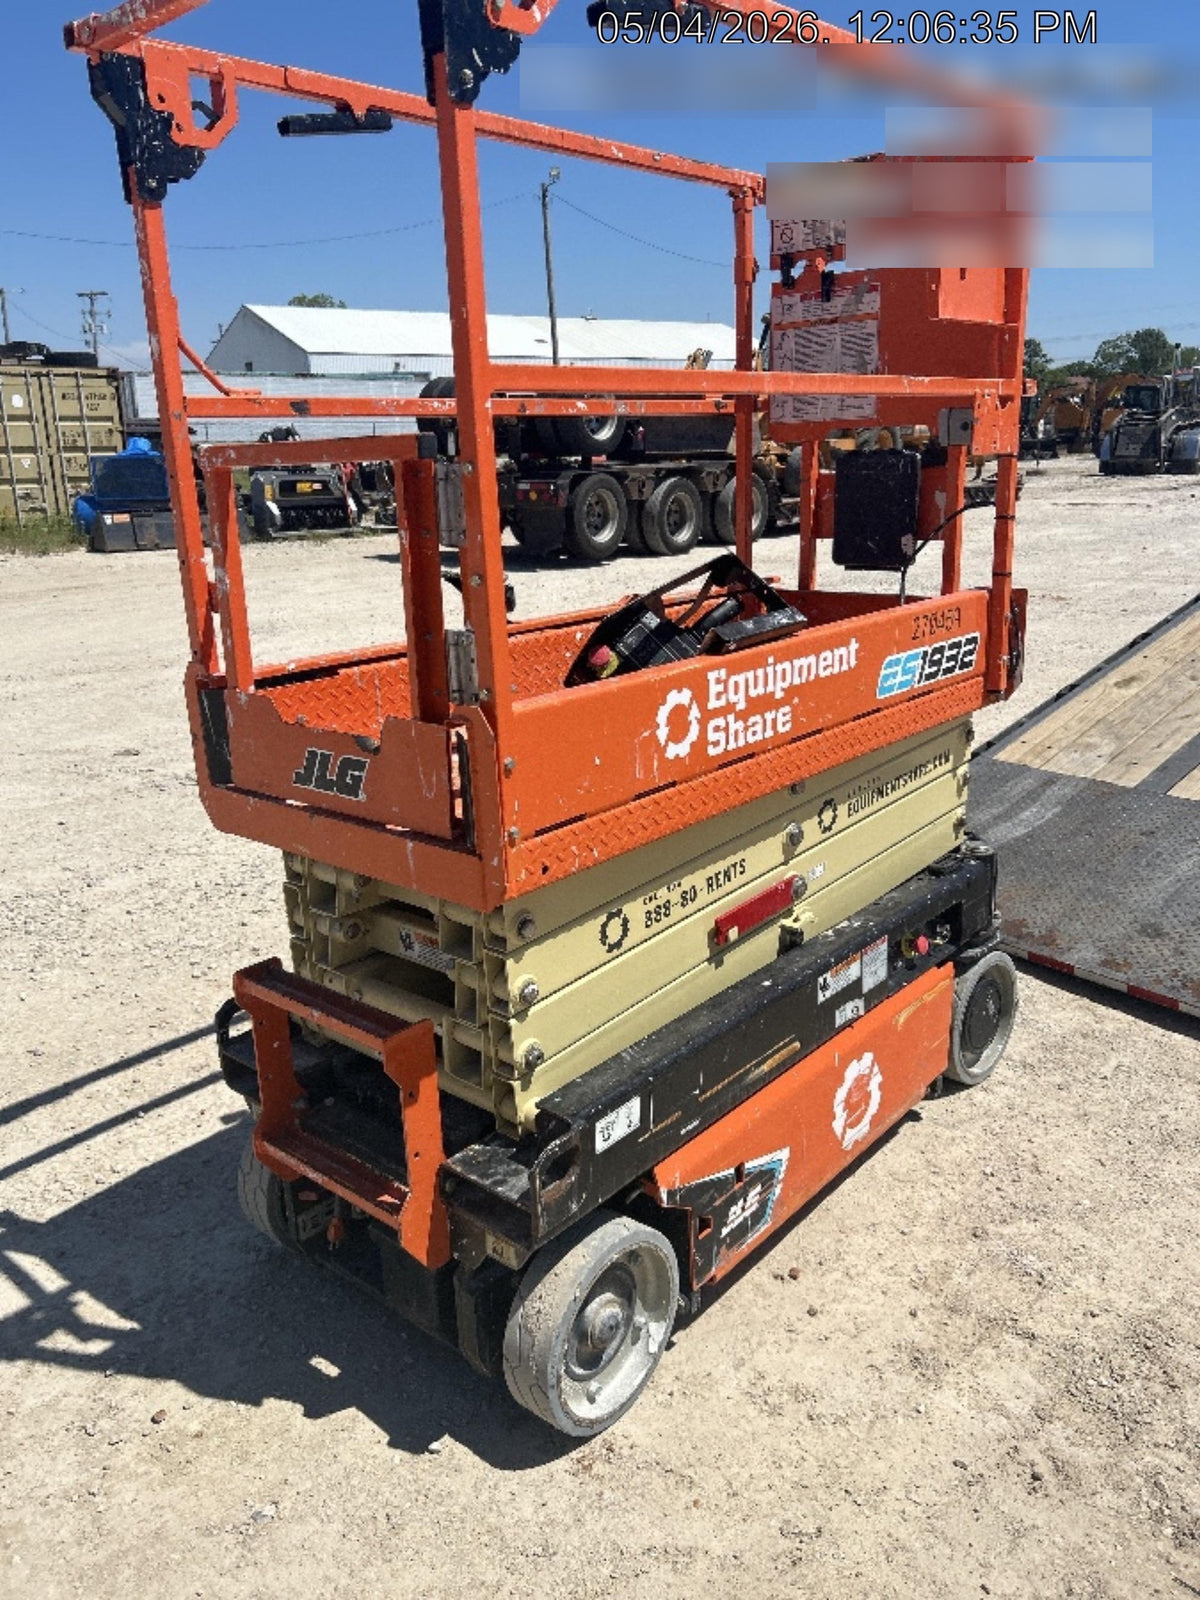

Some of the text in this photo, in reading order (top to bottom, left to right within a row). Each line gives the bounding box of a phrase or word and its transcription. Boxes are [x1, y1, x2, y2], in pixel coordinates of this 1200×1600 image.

[707, 637, 859, 711] Equipment
[877, 632, 980, 699] ES1932
[707, 705, 792, 757] Share
[292, 747, 371, 802] JLG
